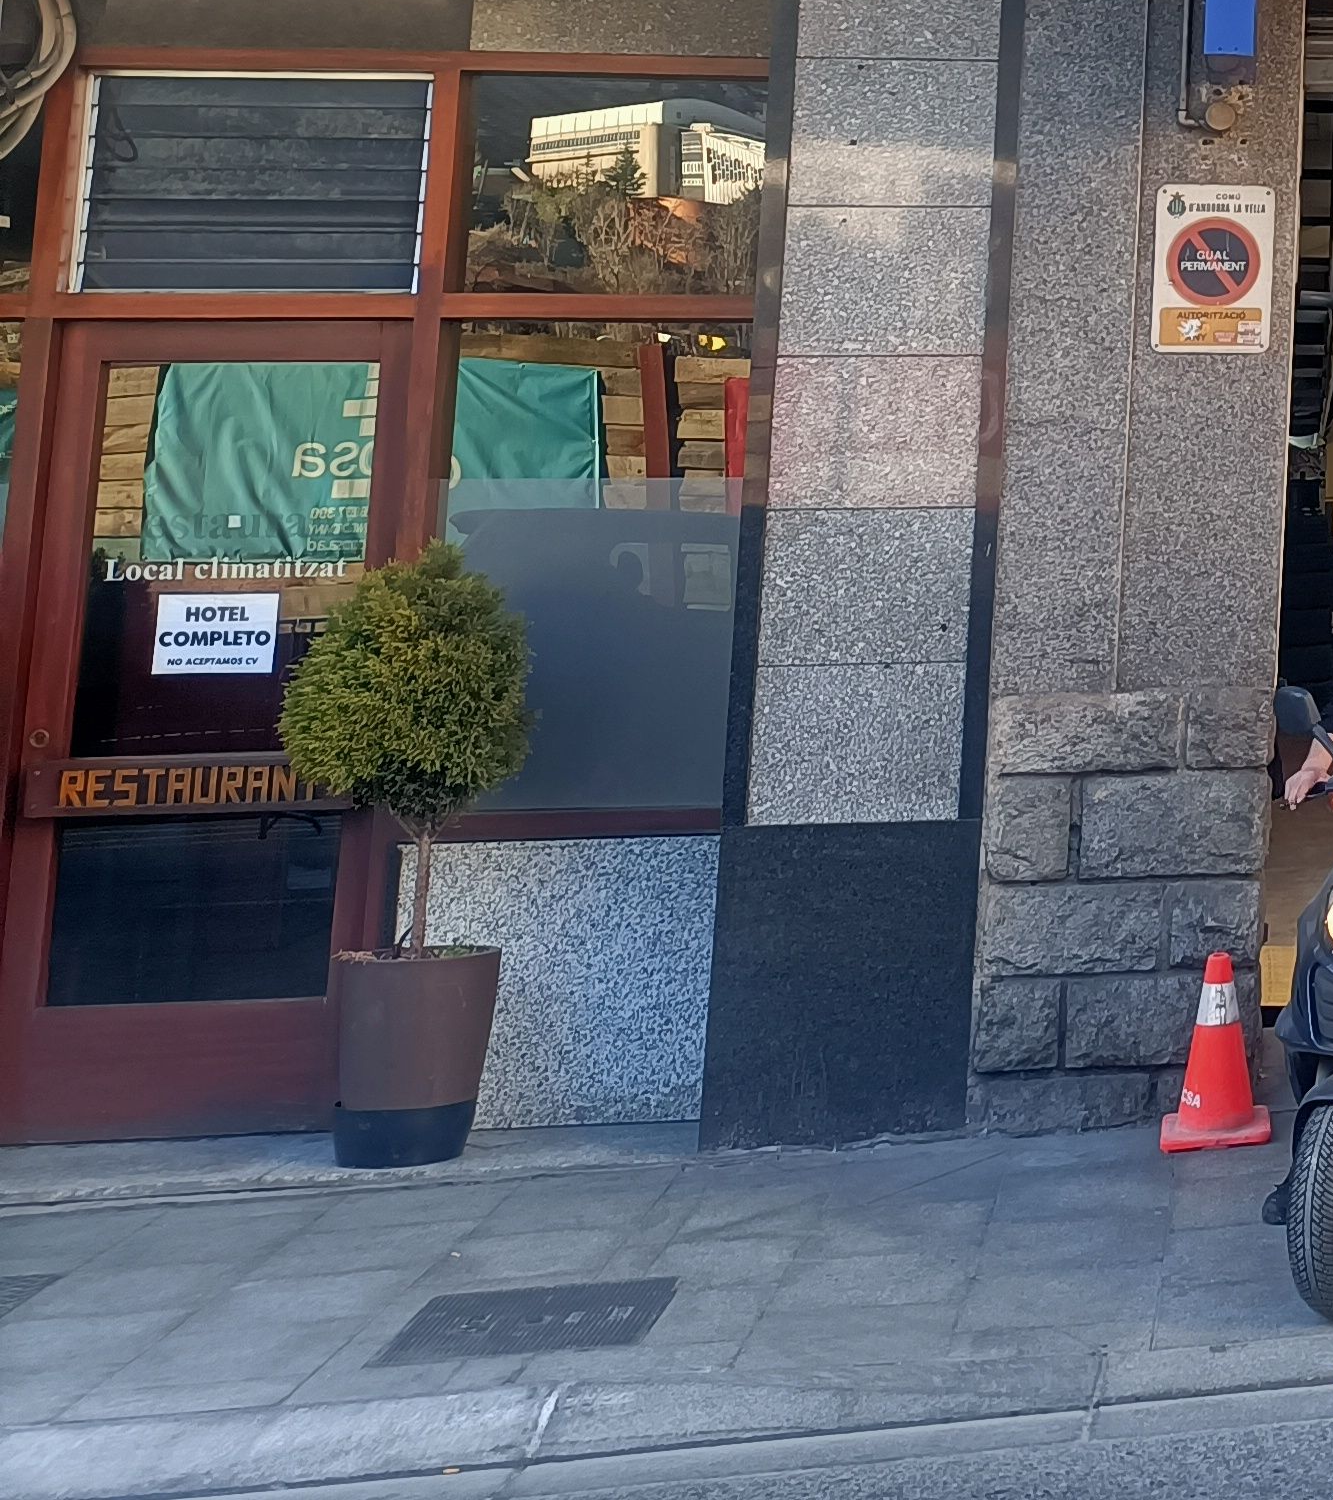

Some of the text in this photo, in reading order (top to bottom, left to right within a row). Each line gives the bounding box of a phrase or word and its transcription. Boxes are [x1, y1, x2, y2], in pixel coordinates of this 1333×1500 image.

[1234, 204, 1242, 213] LA
[1196, 250, 1229, 260] GUAL
[1180, 261, 1247, 272] PERMANENT
[103, 557, 347, 582] Local climatitzat
[185, 606, 250, 622] HOTEL
[159, 630, 271, 647] COMPLETO
[167, 657, 259, 666] NO ACEPTAMOS CV
